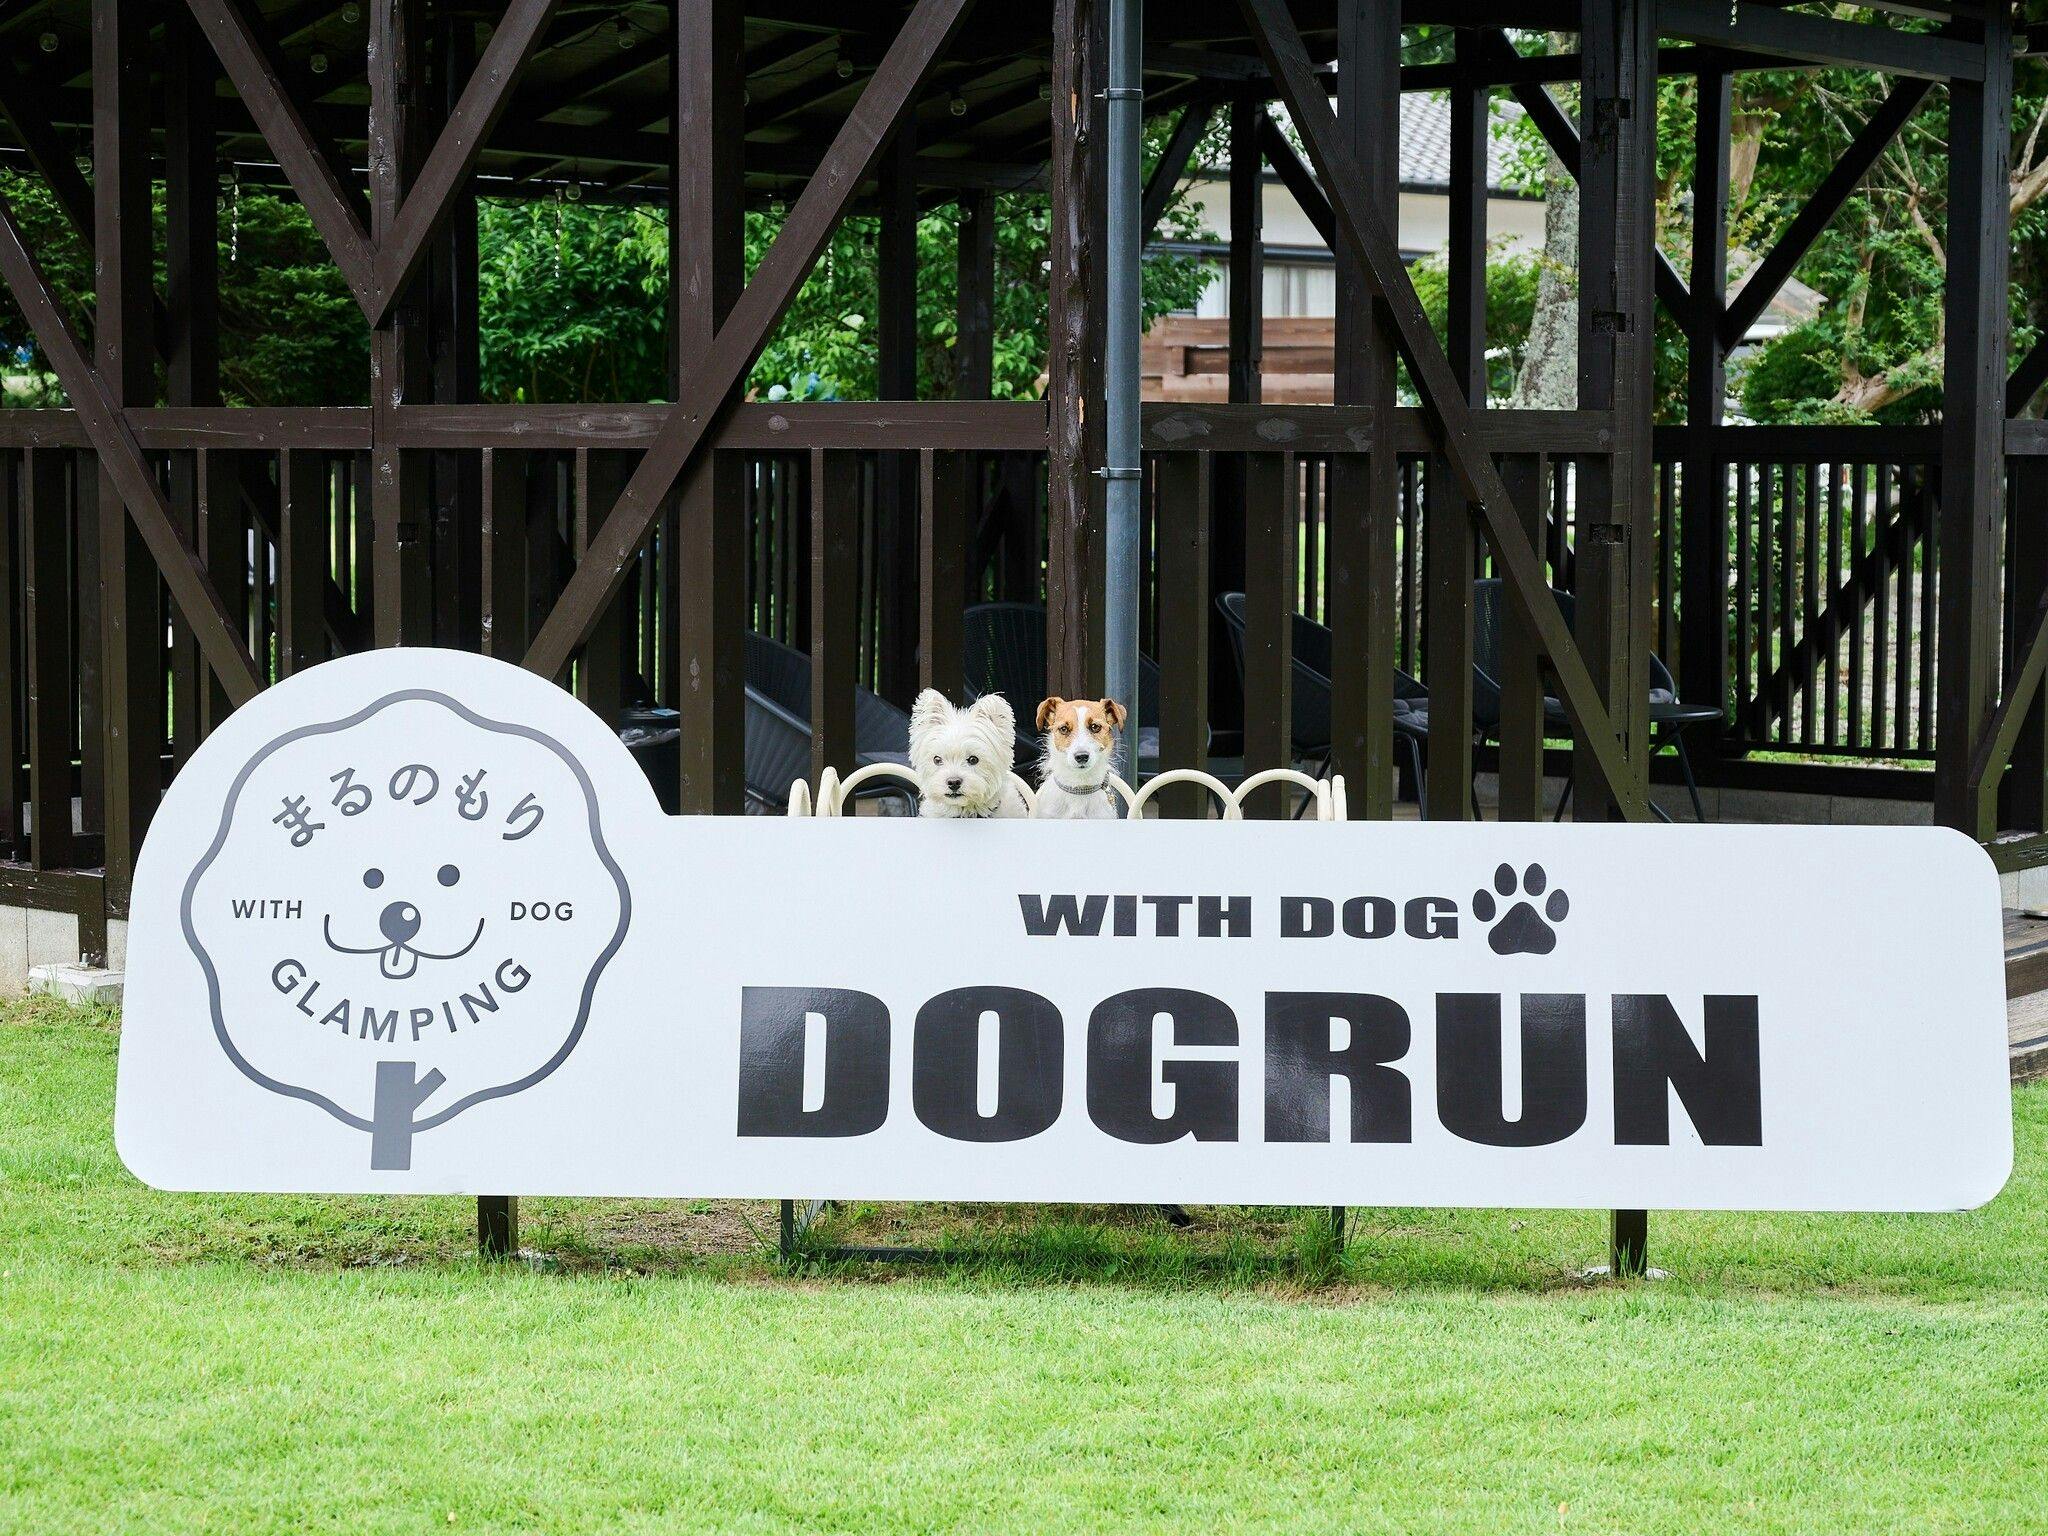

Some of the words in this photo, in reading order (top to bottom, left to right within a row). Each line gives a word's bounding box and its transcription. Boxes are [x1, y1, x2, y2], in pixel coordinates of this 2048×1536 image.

[272, 764, 545, 848] まるのもり
[231, 899, 303, 919] WITH
[510, 901, 574, 922] DOG
[1018, 893, 1252, 938] WITH
[1280, 895, 1459, 940] DOG
[271, 957, 532, 1043] GLAMPING
[736, 985, 1763, 1148] DOGRUN
